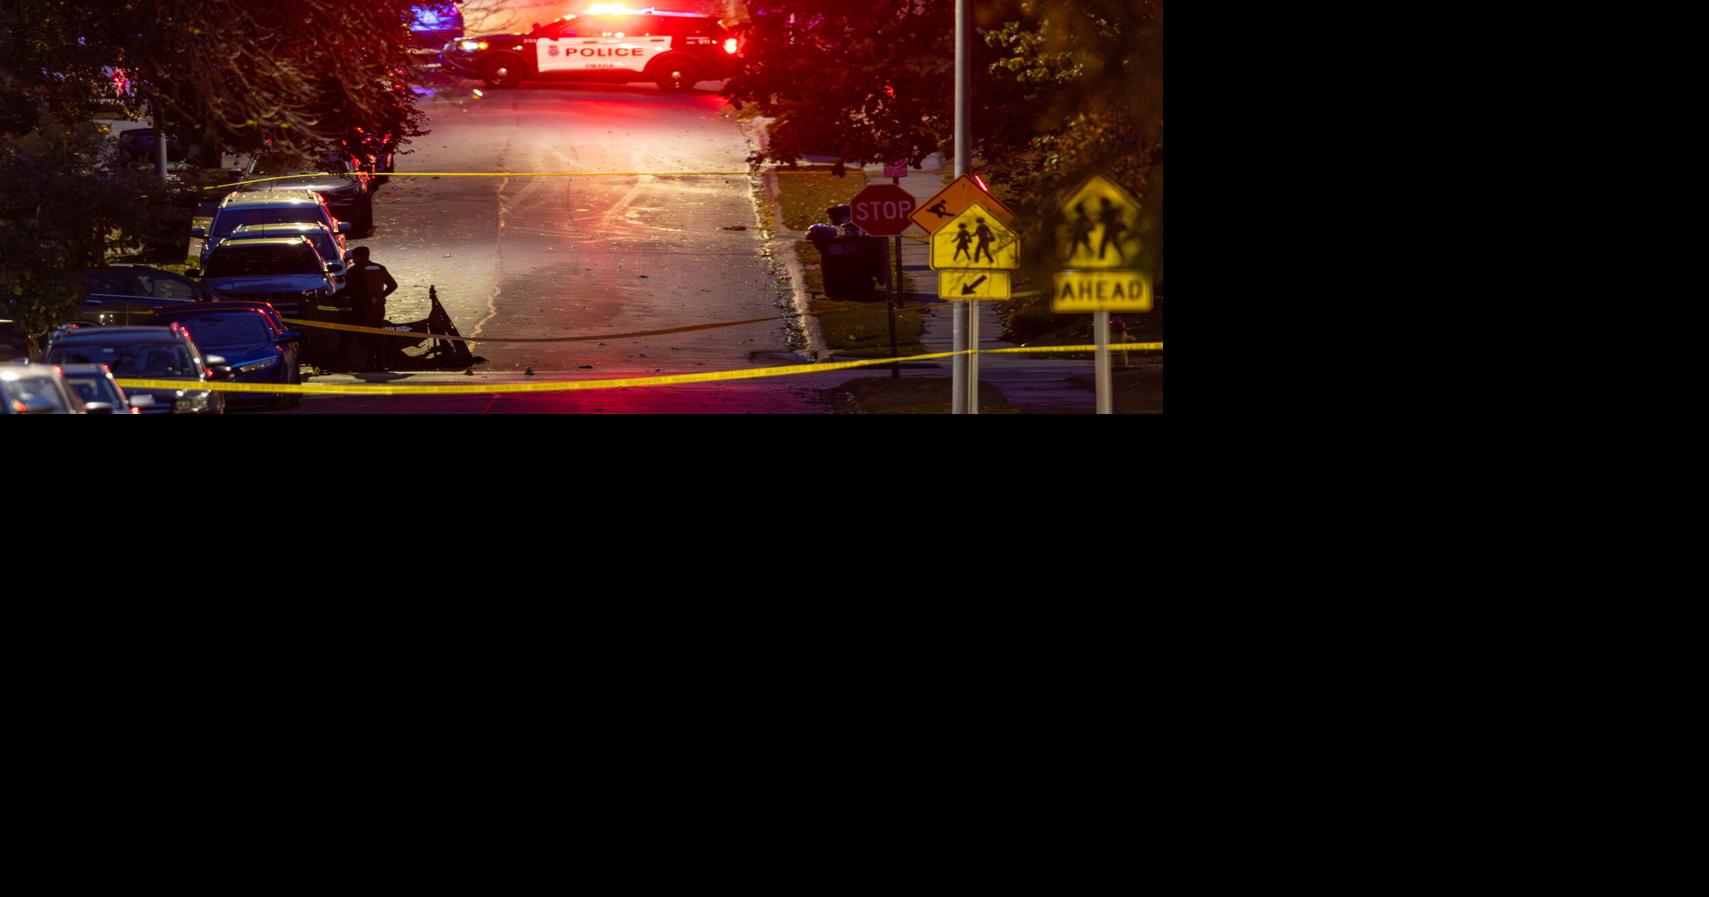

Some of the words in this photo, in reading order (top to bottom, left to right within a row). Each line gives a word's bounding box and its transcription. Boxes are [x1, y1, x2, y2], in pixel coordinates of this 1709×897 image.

[565, 47, 644, 57] POLICE
[856, 200, 912, 220] STOP
[1061, 280, 1144, 301] AHEAD
